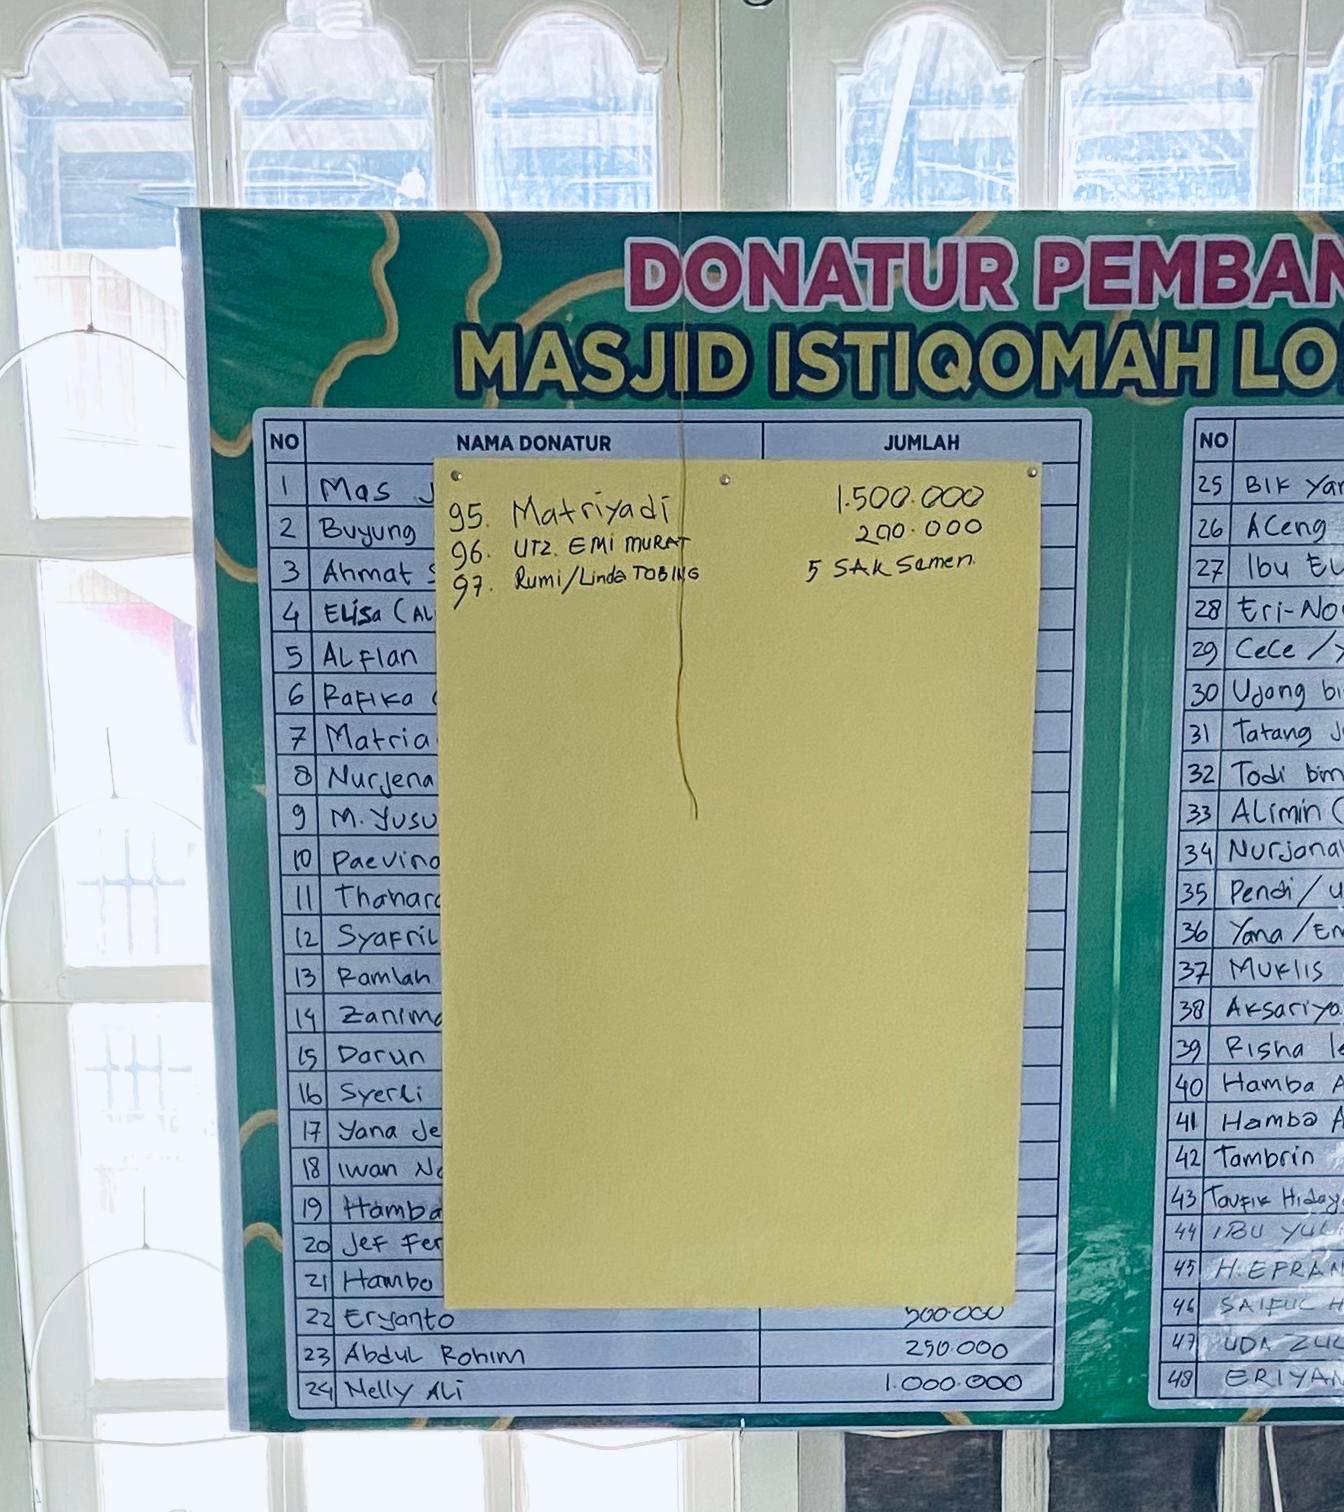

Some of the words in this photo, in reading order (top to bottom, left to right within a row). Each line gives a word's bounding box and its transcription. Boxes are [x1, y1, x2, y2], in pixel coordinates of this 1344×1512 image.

[626, 237, 1017, 310] DONATUR
[458, 326, 751, 396] MASJID
[773, 324, 1215, 397] ISTIQOMAH
[270, 433, 300, 450] NO
[456, 434, 514, 452] NAMA
[520, 434, 612, 452] DONATUR
[883, 434, 960, 451] JUMLAH
[1199, 431, 1229, 449] NO
[1197, 475, 1223, 496] 25
[279, 517, 297, 539] 2
[1197, 517, 1224, 538] 26
[280, 559, 300, 583] 3
[1195, 558, 1225, 583] 27
[282, 601, 300, 632] 4
[1194, 599, 1222, 621] 28
[285, 646, 303, 669] 5
[1192, 641, 1218, 666] 29
[288, 682, 304, 706] 6
[1190, 683, 1219, 707] 30
[289, 726, 307, 750] 7
[1189, 723, 1209, 744] 31
[293, 764, 313, 787] 8
[1187, 764, 1215, 784] 32
[292, 803, 306, 830] 9
[1186, 804, 1212, 825] 33
[293, 849, 312, 871] 10
[1184, 842, 1213, 866] 34
[296, 884, 313, 911] 11
[1179, 882, 1208, 906] 35
[295, 926, 319, 949] 12
[1180, 920, 1208, 945] 36
[295, 966, 317, 988] 13
[1178, 961, 1210, 985] 37
[295, 1007, 317, 1033] 14
[1178, 999, 1205, 1022] 38
[298, 1046, 318, 1071] 15
[1175, 1038, 1202, 1063] 39
[299, 1082, 323, 1105] 16
[1175, 1073, 1204, 1101] 40
[302, 1120, 322, 1143] 17
[1175, 1111, 1197, 1133] 41
[302, 1156, 321, 1181] 18
[1175, 1144, 1202, 1170] 42
[302, 1197, 323, 1221] 19
[1171, 1185, 1197, 1210] 43
[1174, 1222, 1198, 1241] 44
[302, 1235, 332, 1254] 20
[1173, 1257, 1198, 1278] 45
[306, 1272, 328, 1293] 21
[306, 1307, 335, 1329] 22
[1172, 1296, 1194, 1317] 46
[1171, 1333, 1196, 1351] 47
[304, 1346, 333, 1368] 23
[306, 1380, 334, 1400] 24
[1167, 1369, 1194, 1388] 48
